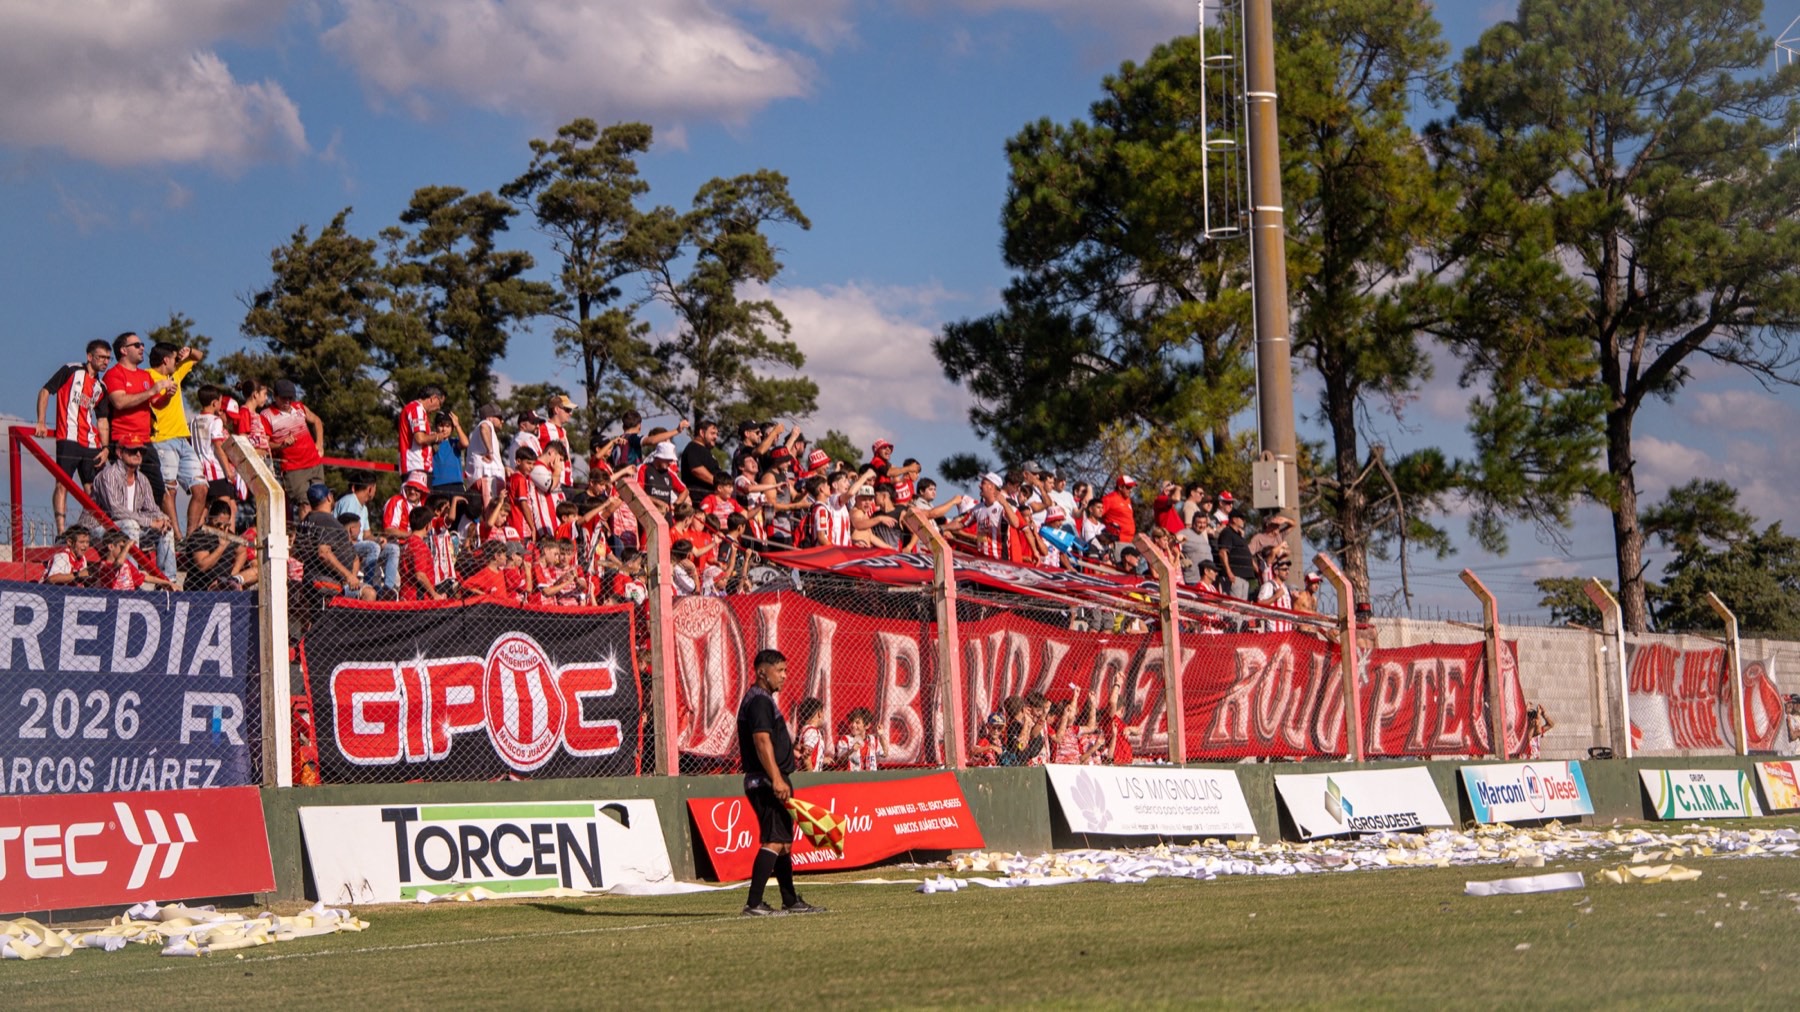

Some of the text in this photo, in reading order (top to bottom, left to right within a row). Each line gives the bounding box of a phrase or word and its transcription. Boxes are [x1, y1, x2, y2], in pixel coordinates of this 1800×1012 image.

[0, 591, 234, 678] REDIA
[499, 649, 538, 668] ARGENTINO
[508, 644, 530, 656] CLUB
[18, 688, 142, 740] 2026
[180, 690, 245, 746] FR
[499, 730, 526, 758] MARCOS
[0, 748, 222, 793] RCOS JUÁREZ
[1115, 776, 1223, 801] LAS MAGNOLIAS
[1476, 778, 1527, 805] Marconi
[1543, 775, 1580, 800] Diesel
[1675, 784, 1740, 812] C.I.M.A.
[711, 799, 753, 854] La
[1347, 812, 1422, 832] AGROSUDESTE
[381, 806, 604, 888] TORCEN
